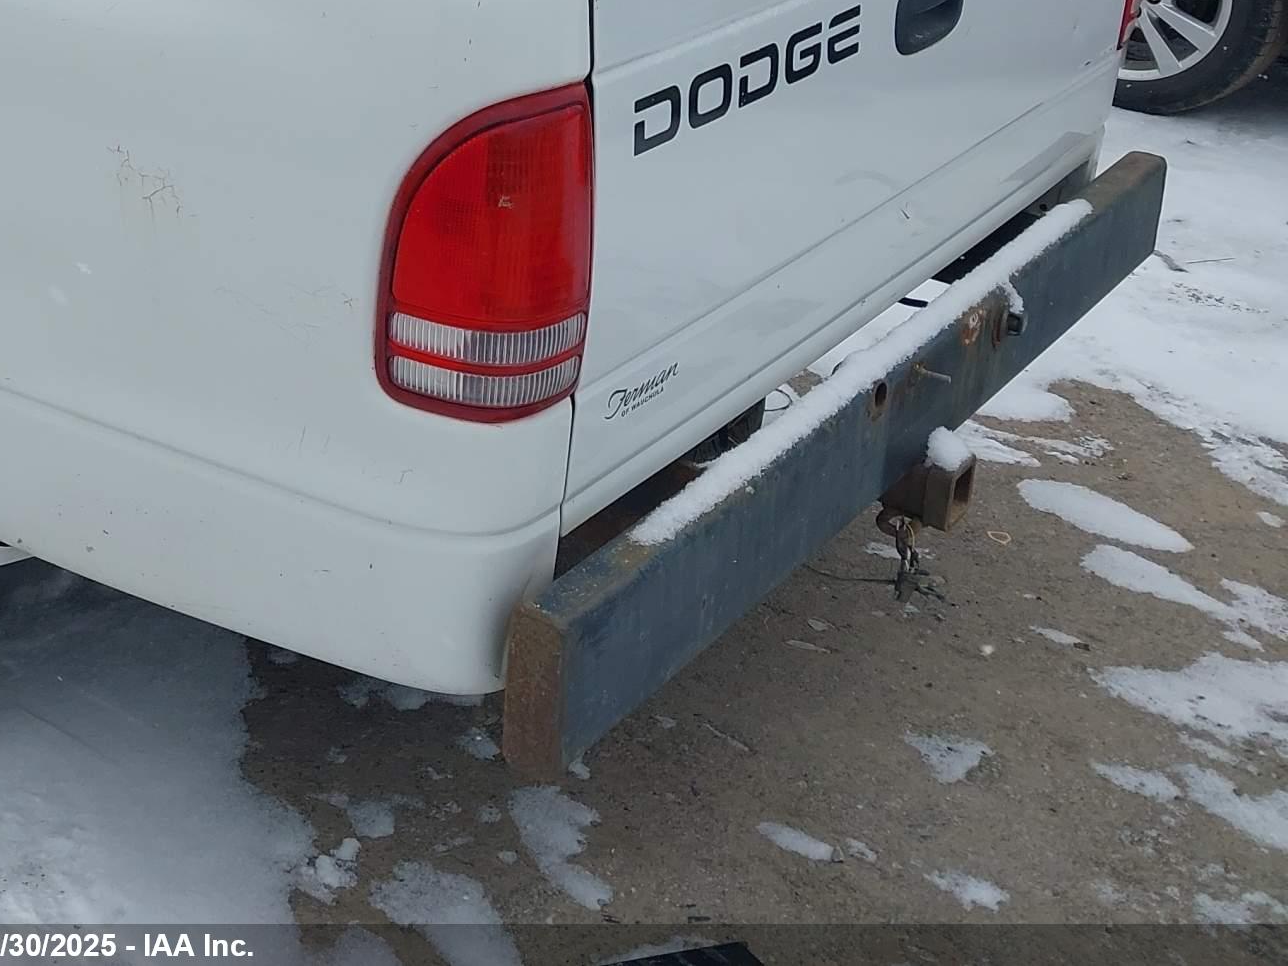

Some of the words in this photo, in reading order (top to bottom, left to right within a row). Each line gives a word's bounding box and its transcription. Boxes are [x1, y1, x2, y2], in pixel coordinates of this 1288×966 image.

[634, 5, 861, 156] DODGE
[604, 362, 679, 420] Ferman
[621, 408, 630, 417] OF
